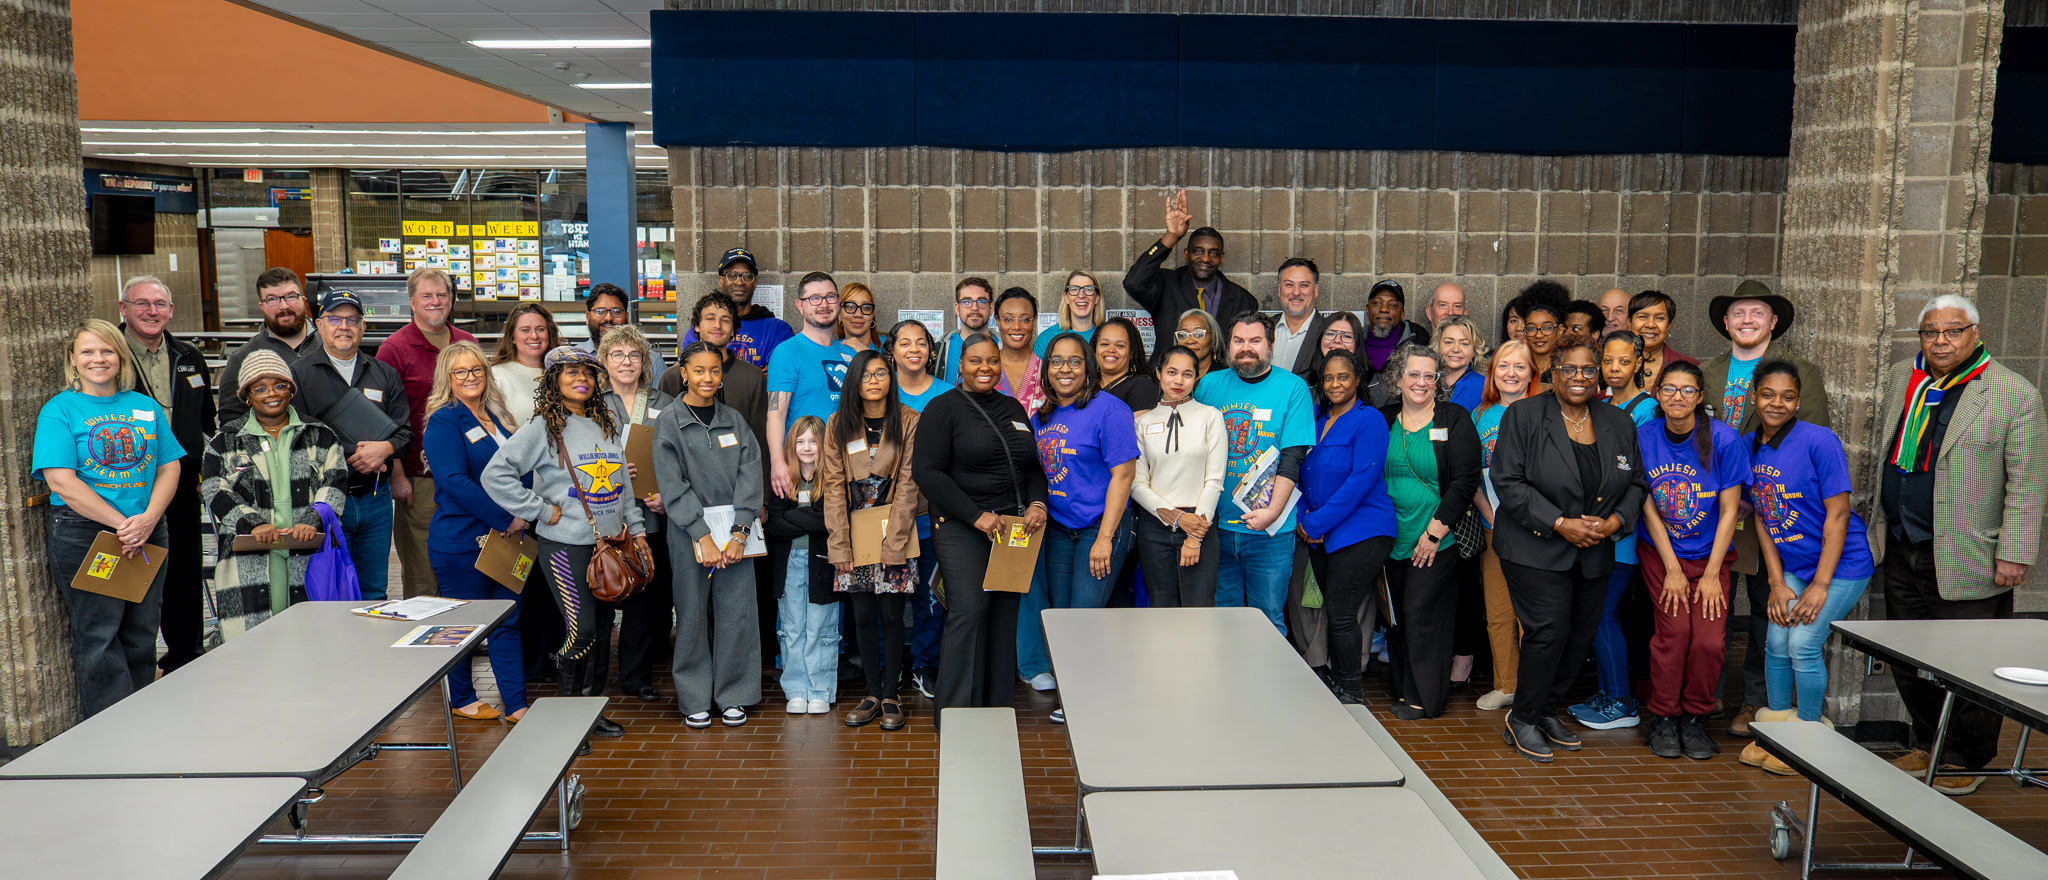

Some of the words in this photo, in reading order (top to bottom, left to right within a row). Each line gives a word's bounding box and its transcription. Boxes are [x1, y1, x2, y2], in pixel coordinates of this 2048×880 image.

[247, 169, 260, 181] EXIT
[104, 178, 116, 187] YOU
[404, 223, 451, 234] WORD
[489, 224, 536, 234] WEEK
[1131, 317, 1154, 326] NESS
[748, 348, 757, 356] TH
[84, 414, 136, 426] WHJESP
[1255, 422, 1263, 430] TH
[1059, 439, 1066, 447] TH
[1648, 463, 1697, 478] WHJESP
[1752, 464, 1781, 478] HJESP
[1691, 483, 1702, 492] TH
[1776, 484, 1786, 493] TH
[1686, 510, 1707, 530] FAIR
[1781, 510, 1800, 530] FAIR
